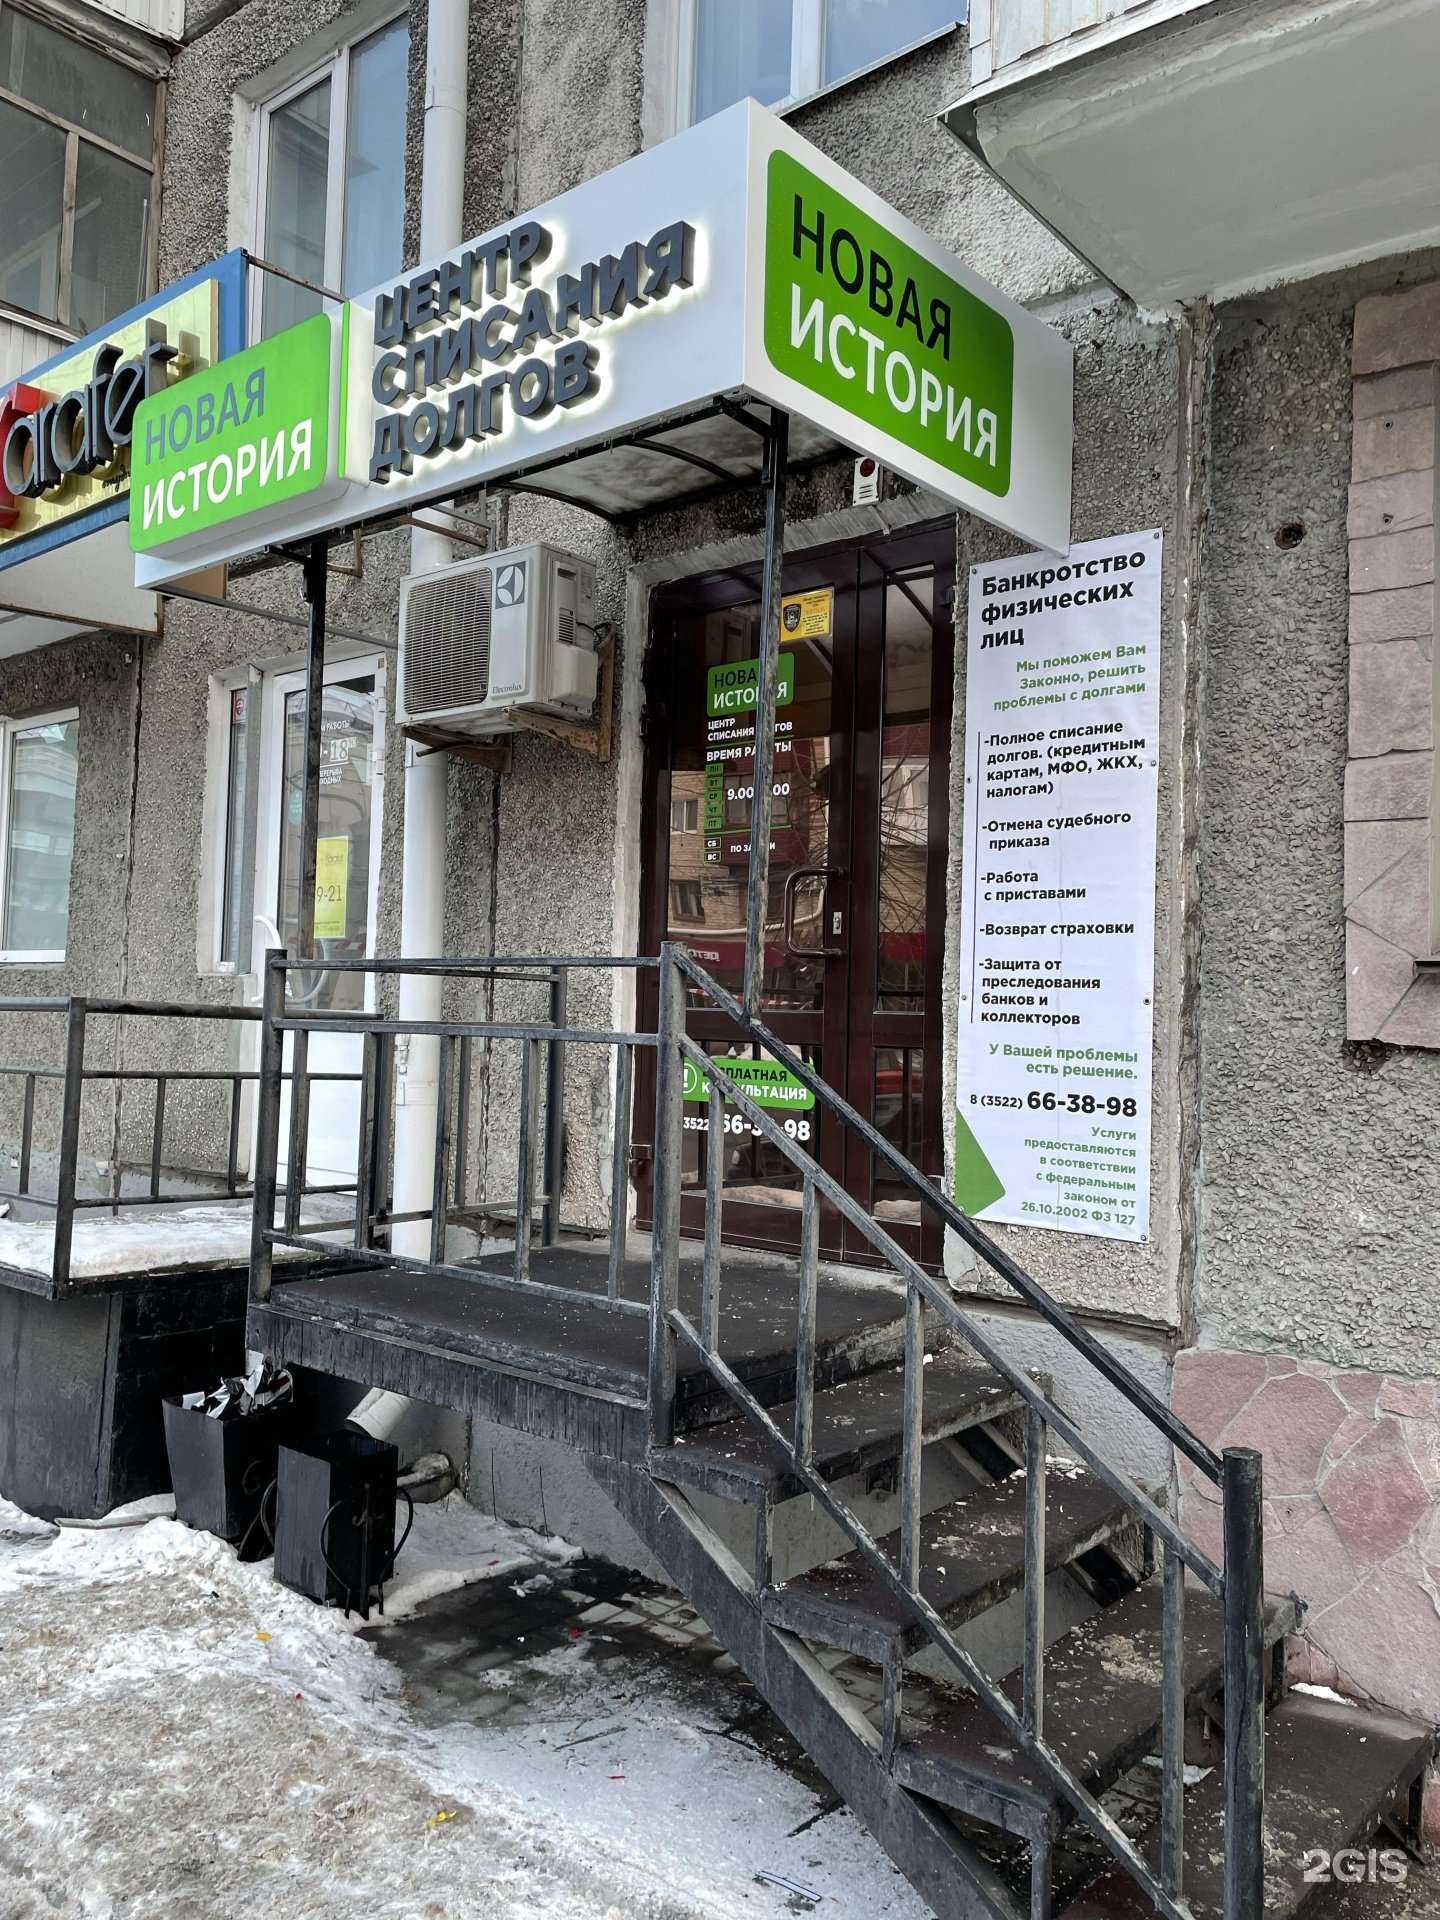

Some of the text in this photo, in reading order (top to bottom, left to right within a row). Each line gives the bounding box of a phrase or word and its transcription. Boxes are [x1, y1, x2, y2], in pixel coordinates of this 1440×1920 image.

[374, 221, 552, 348] ЦЕНТР
[792, 193, 952, 361] НОВАЯ
[372, 220, 695, 408] СПИСАНИЯ
[790, 282, 998, 468] ИСТОРИЯ
[145, 367, 265, 466] НОВАЯ
[369, 340, 601, 484] ДОЛГОВ
[142, 418, 313, 531] ИСТОРИЯ
[982, 552, 1146, 596] Банкротство
[981, 581, 1134, 625] физических
[980, 628, 1025, 649] лиц
[1016, 644, 1146, 672] Мы поможем Вам
[714, 667, 758, 688] НОВА
[1020, 664, 1146, 689] Законно, решить
[713, 681, 788, 709] ИСТОЯ
[993, 682, 1146, 712] проблемы с долгами
[708, 718, 736, 730] ЦЕНТР
[707, 727, 755, 741] СПИСАНИЯ
[984, 722, 1123, 747] -Полное списание
[706, 741, 792, 761] ВРЕМЯ РАТЫ
[987, 738, 1146, 766] долгов. (кредитным
[987, 755, 1143, 782] картам, МФО, ЖКХ,
[986, 782, 1054, 799] налогам)
[982, 813, 1131, 832] -Отмена судебного
[989, 836, 1050, 851] приказа
[980, 871, 1039, 884] -Работа
[984, 888, 1086, 902] с приставами
[979, 923, 1134, 937] -Возврат страховки
[979, 958, 1062, 971] -Защита от
[982, 977, 1101, 989] преследования
[982, 993, 1048, 1006] банков и
[981, 1012, 1080, 1026] коллекторов
[989, 1044, 1138, 1063] У Вашей проблемы
[703, 1066, 788, 1082] ПЛАТНАЯ
[1026, 1063, 1138, 1079] есть решение.
[702, 1081, 807, 1100] КЛЬТАЦИЯ
[970, 1091, 1137, 1117] 8 (3522) 66-38-98
[1091, 1127, 1137, 1141] Услуги
[1024, 1138, 1136, 1157] предоставляются
[1040, 1156, 1136, 1174] в соответствии
[1036, 1172, 1136, 1191] с федеральным
[1063, 1191, 1136, 1208] законом от
[1021, 1201, 1136, 1226] 26.10.2002 ФЗ 127
